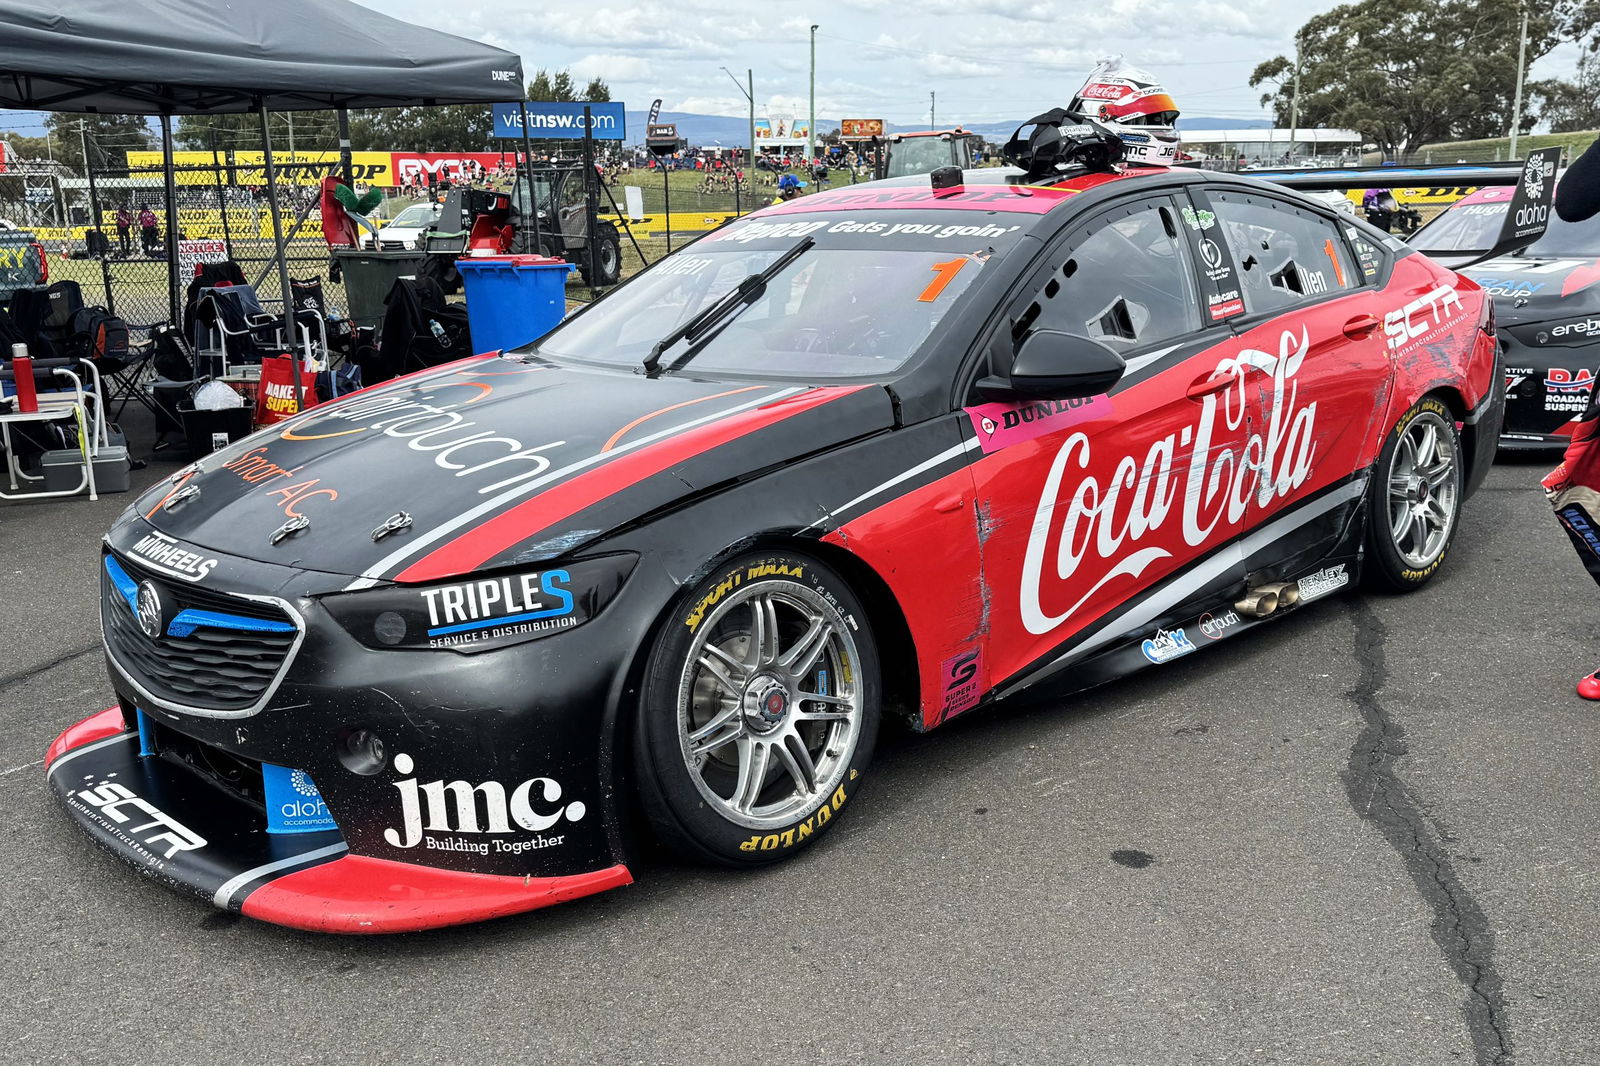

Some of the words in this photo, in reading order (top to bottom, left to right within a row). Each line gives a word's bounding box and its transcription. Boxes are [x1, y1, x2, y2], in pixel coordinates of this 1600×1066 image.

[502, 109, 616, 129] visitnsw.com
[398, 159, 482, 187] RYCO
[1515, 203, 1548, 227] aloha
[827, 221, 886, 234] Gets
[881, 223, 940, 238] you
[179, 244, 223, 252] NOTICE
[917, 258, 969, 303] 1
[1384, 284, 1464, 350] SCTR
[265, 381, 293, 399] MAKE
[1544, 403, 1588, 411] SUSPEN
[329, 397, 567, 494] airtouch
[222, 448, 304, 490] Smart
[265, 478, 338, 518] AC
[430, 632, 478, 649] SERVICE
[482, 630, 489, 640] &
[493, 616, 578, 639] DISTRIBUTION
[1202, 610, 1240, 634] airtouch
[78, 782, 207, 859] SCTR
[284, 818, 336, 826] accommoda
[739, 783, 847, 851] DUNLOP
[426, 836, 489, 855] Building
[492, 835, 565, 855] Together
